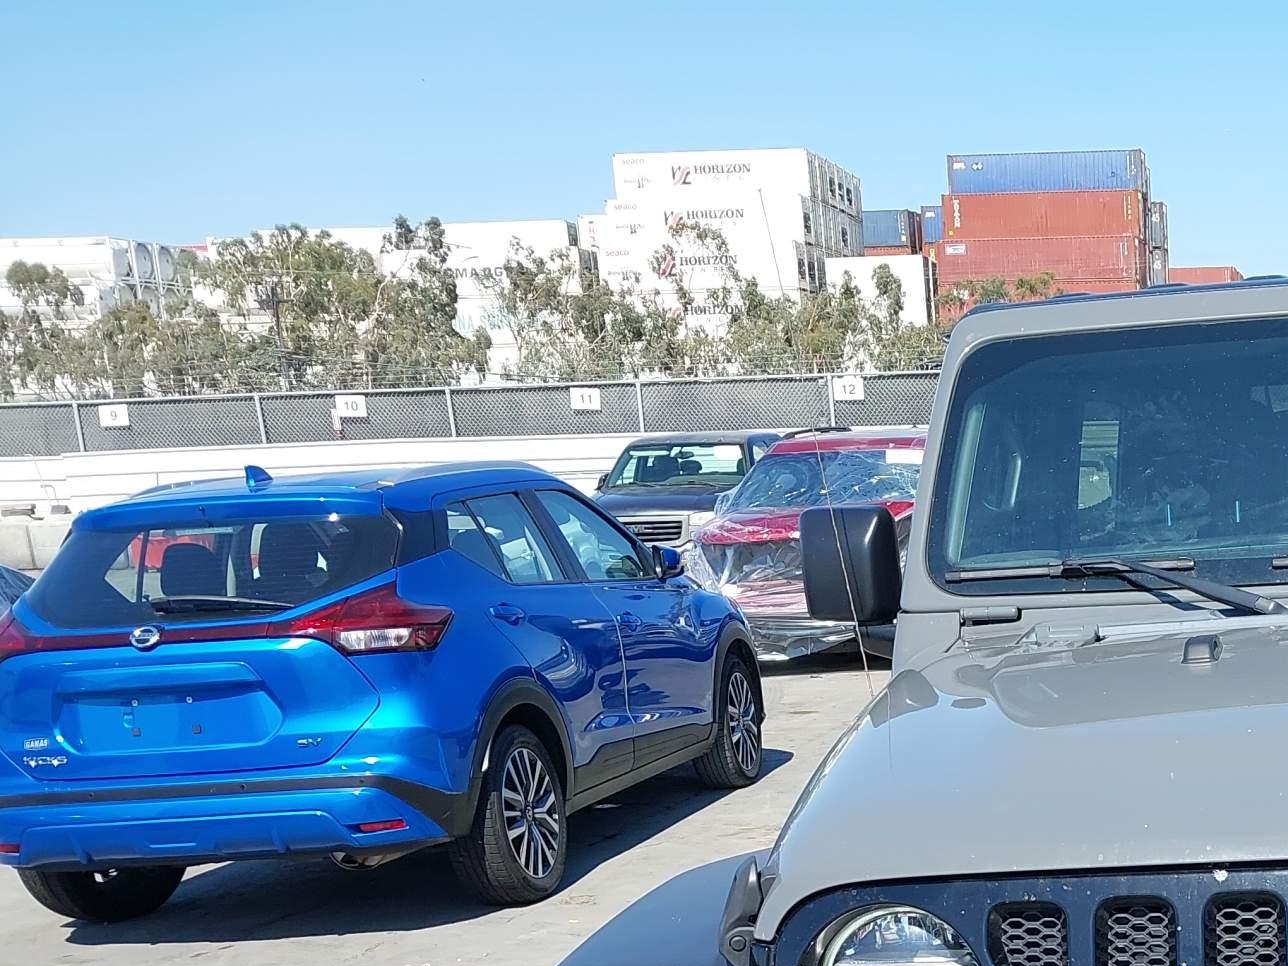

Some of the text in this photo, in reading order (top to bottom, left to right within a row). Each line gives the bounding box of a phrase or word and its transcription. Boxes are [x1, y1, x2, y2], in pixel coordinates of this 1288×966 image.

[693, 163, 751, 175] HORIZON
[686, 208, 745, 220] HORIZON
[679, 254, 738, 266] HORIZON
[685, 304, 743, 316] HORIZON
[841, 383, 857, 395] 12
[580, 393, 592, 405] 11
[344, 400, 358, 411] 10
[110, 410, 118, 421] 9
